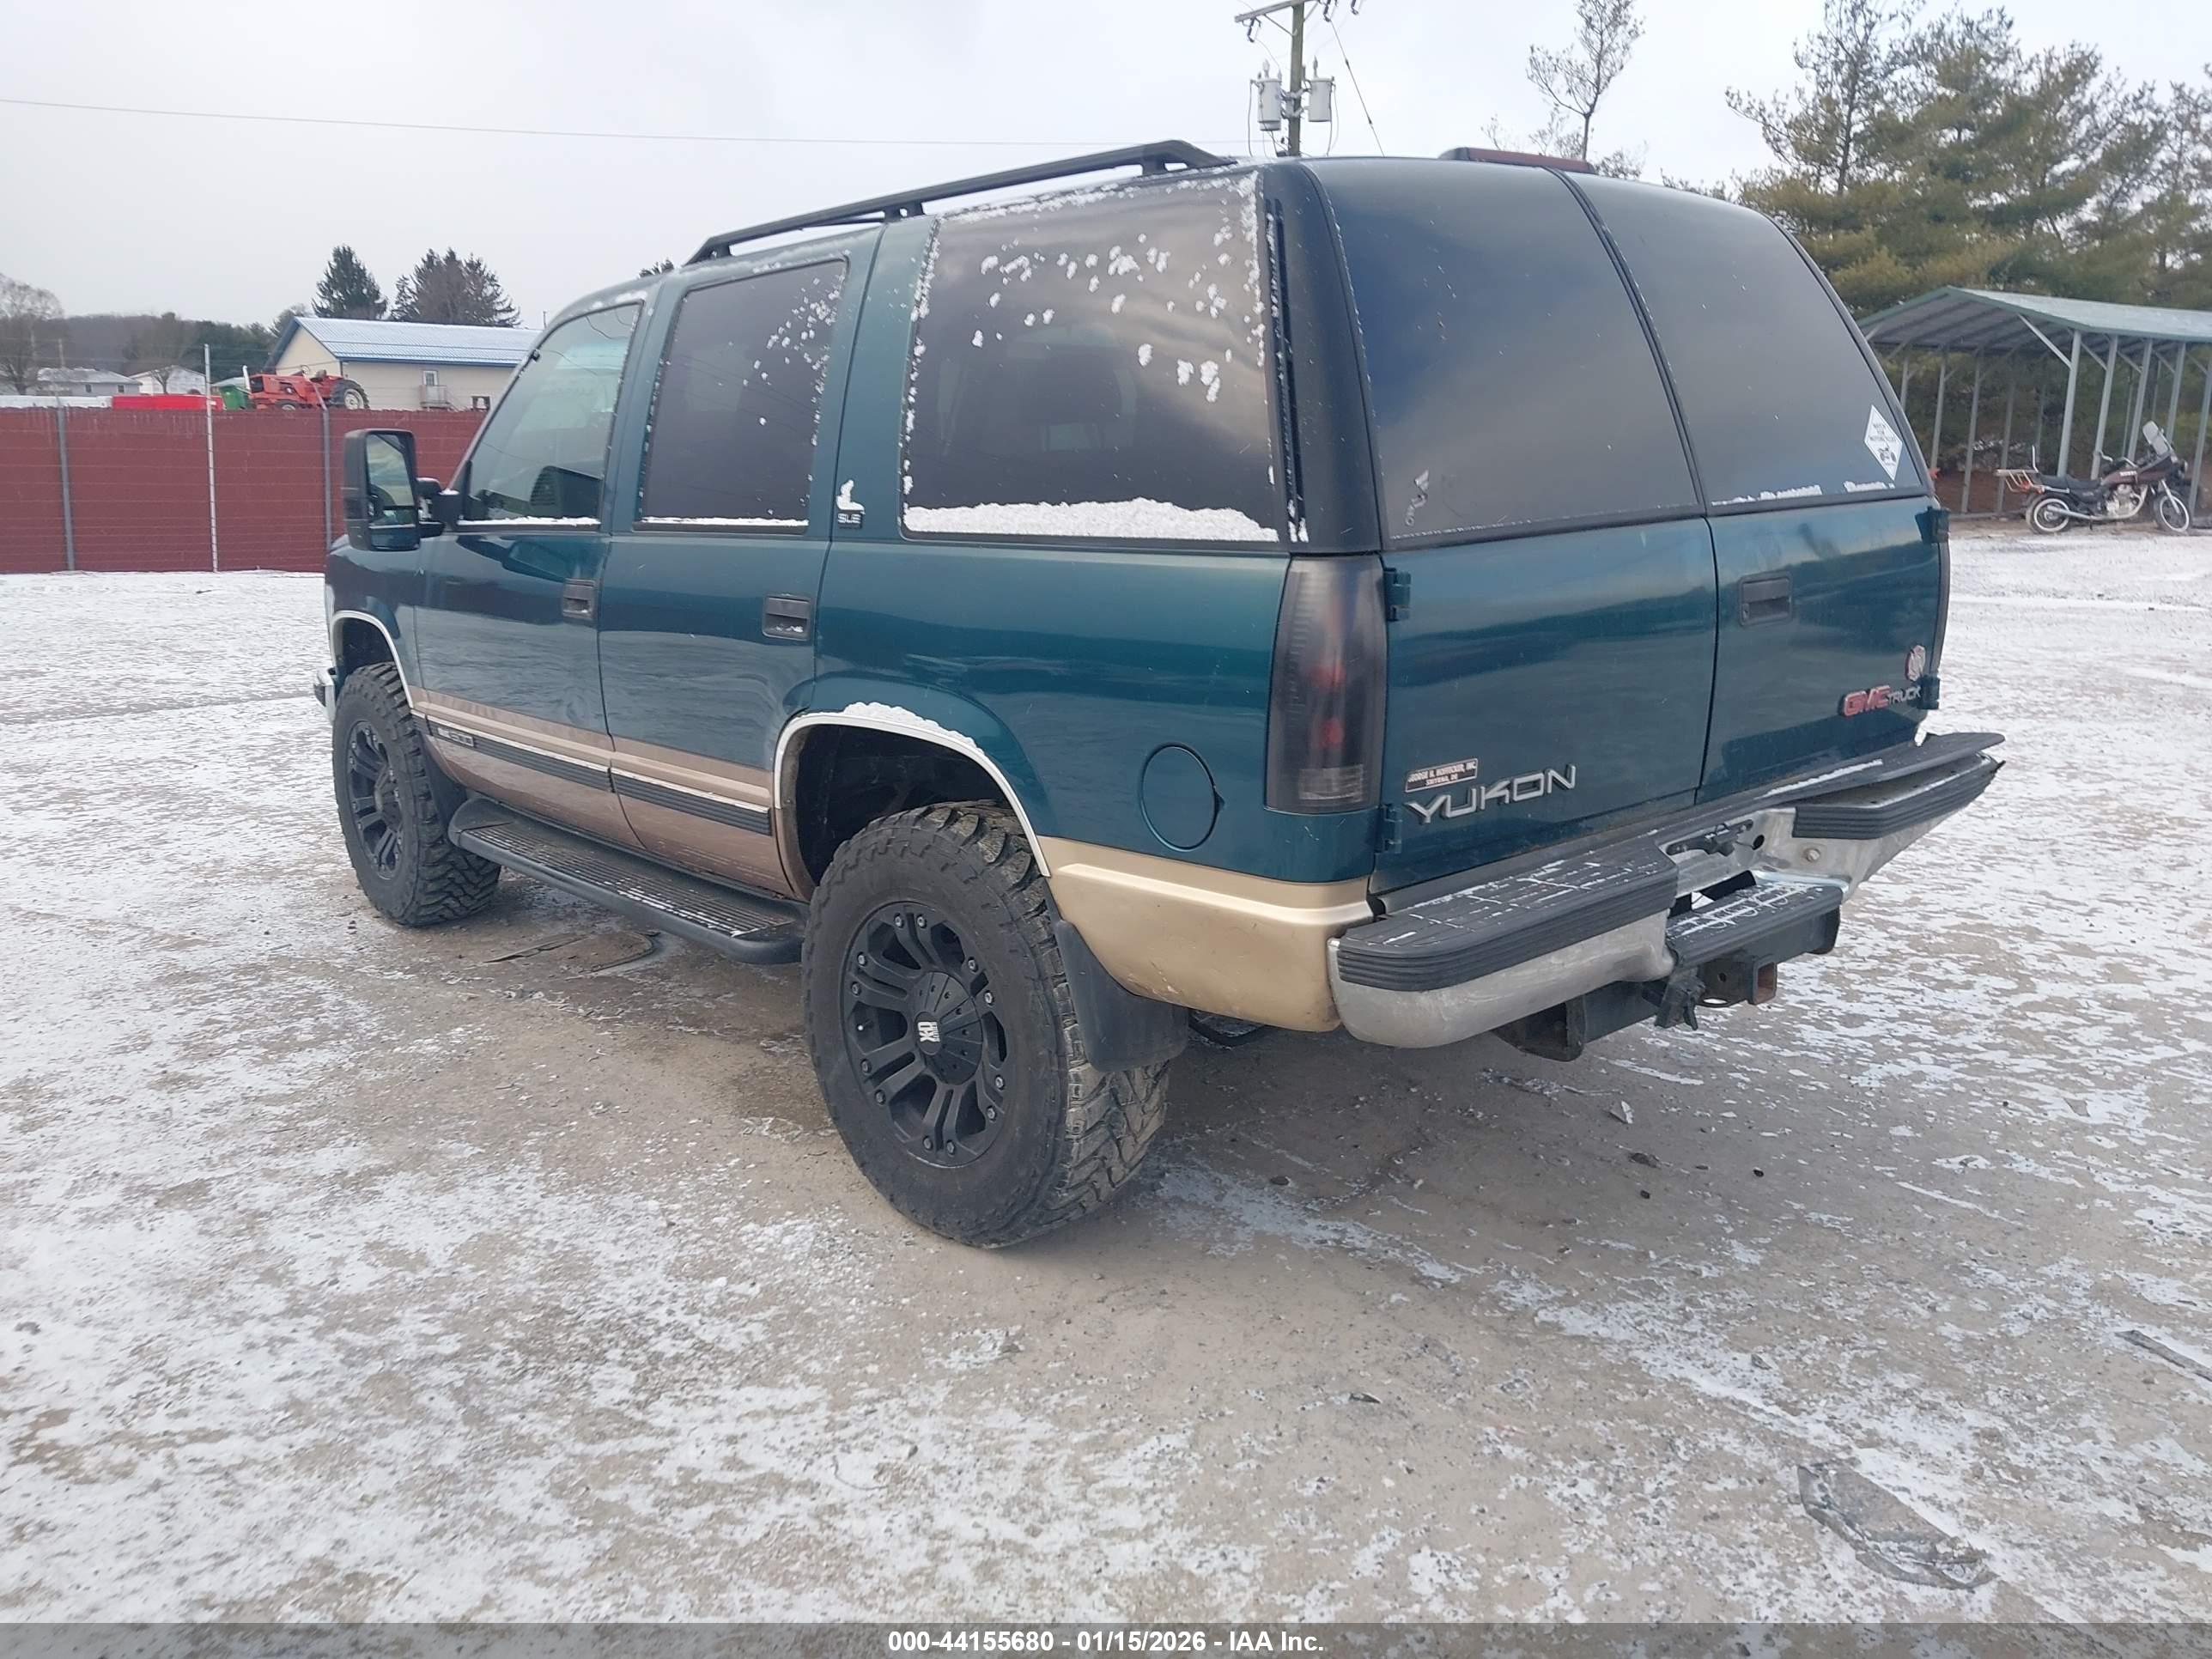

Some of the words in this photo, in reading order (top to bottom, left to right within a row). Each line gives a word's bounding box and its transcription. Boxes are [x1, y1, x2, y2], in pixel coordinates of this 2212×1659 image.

[838, 513, 861, 524] SLE
[1843, 684, 1890, 717] GMC
[1888, 686, 1922, 704] TRUCK
[1403, 763, 1577, 824] YUKON
